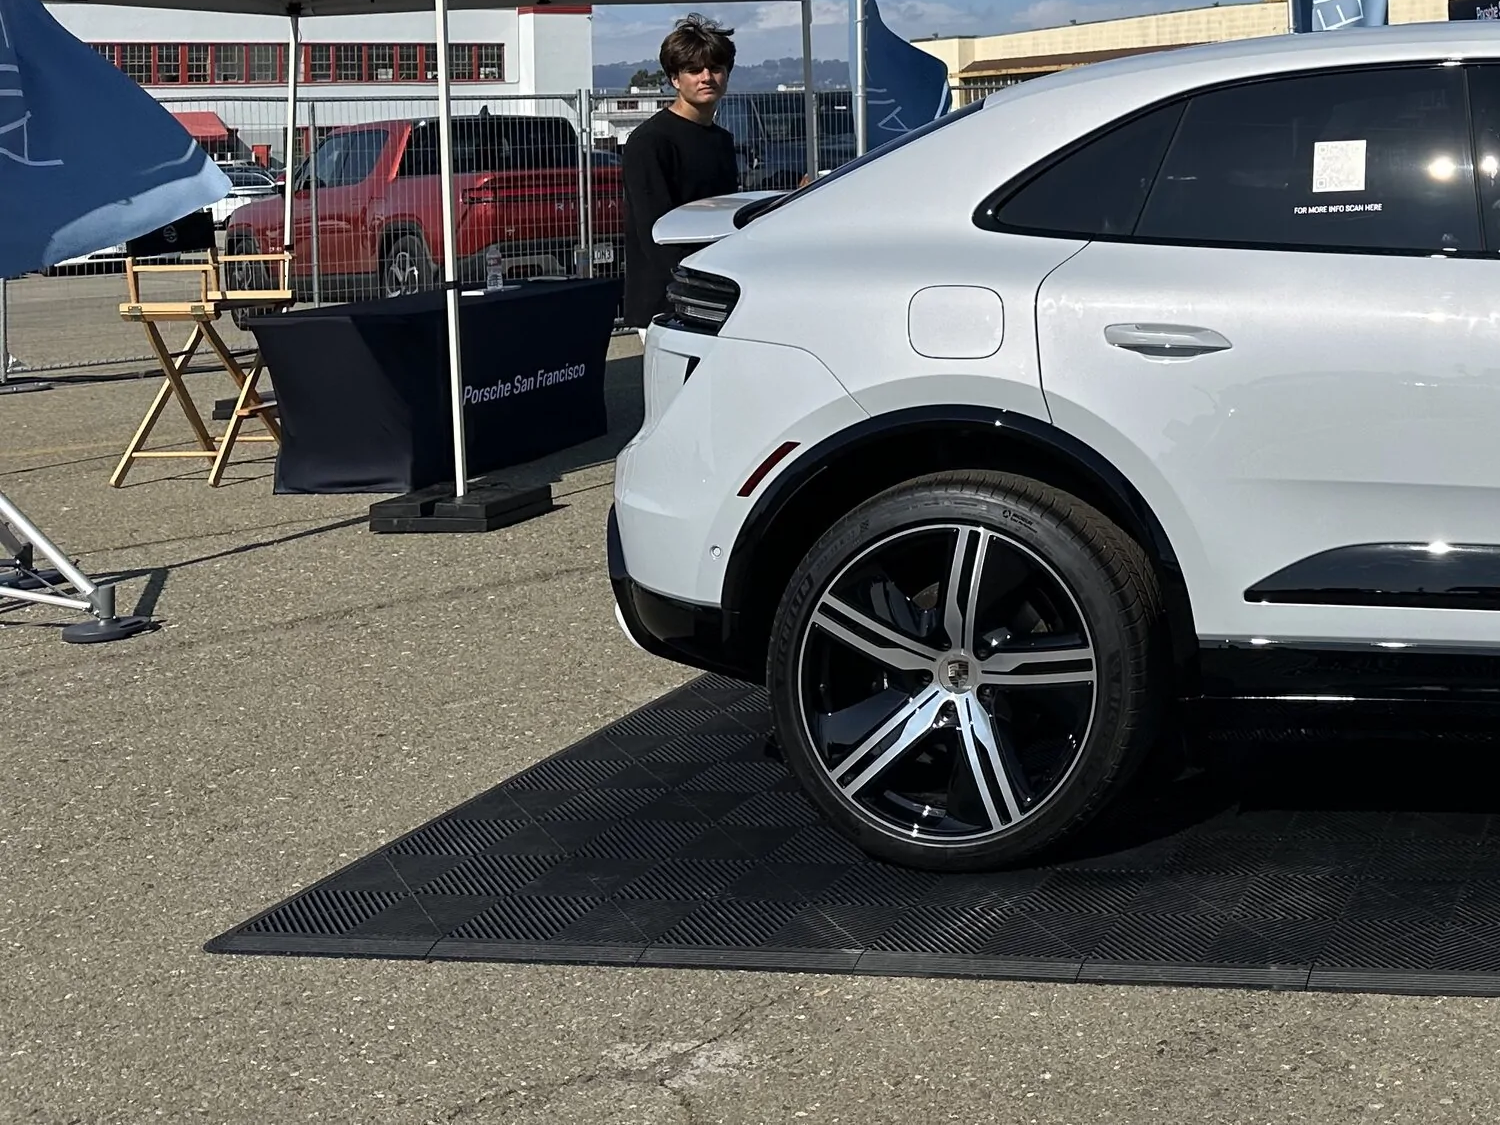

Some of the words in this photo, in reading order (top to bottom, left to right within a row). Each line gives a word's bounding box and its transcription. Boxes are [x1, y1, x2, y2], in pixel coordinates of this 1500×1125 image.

[1294, 206, 1307, 214] FOR
[1308, 205, 1327, 214] MORE
[1328, 205, 1344, 213] INFO
[1345, 204, 1364, 212] SCAN
[1364, 203, 1383, 212] HERE
[462, 379, 511, 406] Porsche
[513, 374, 535, 395] San
[536, 363, 586, 389] Francisco
